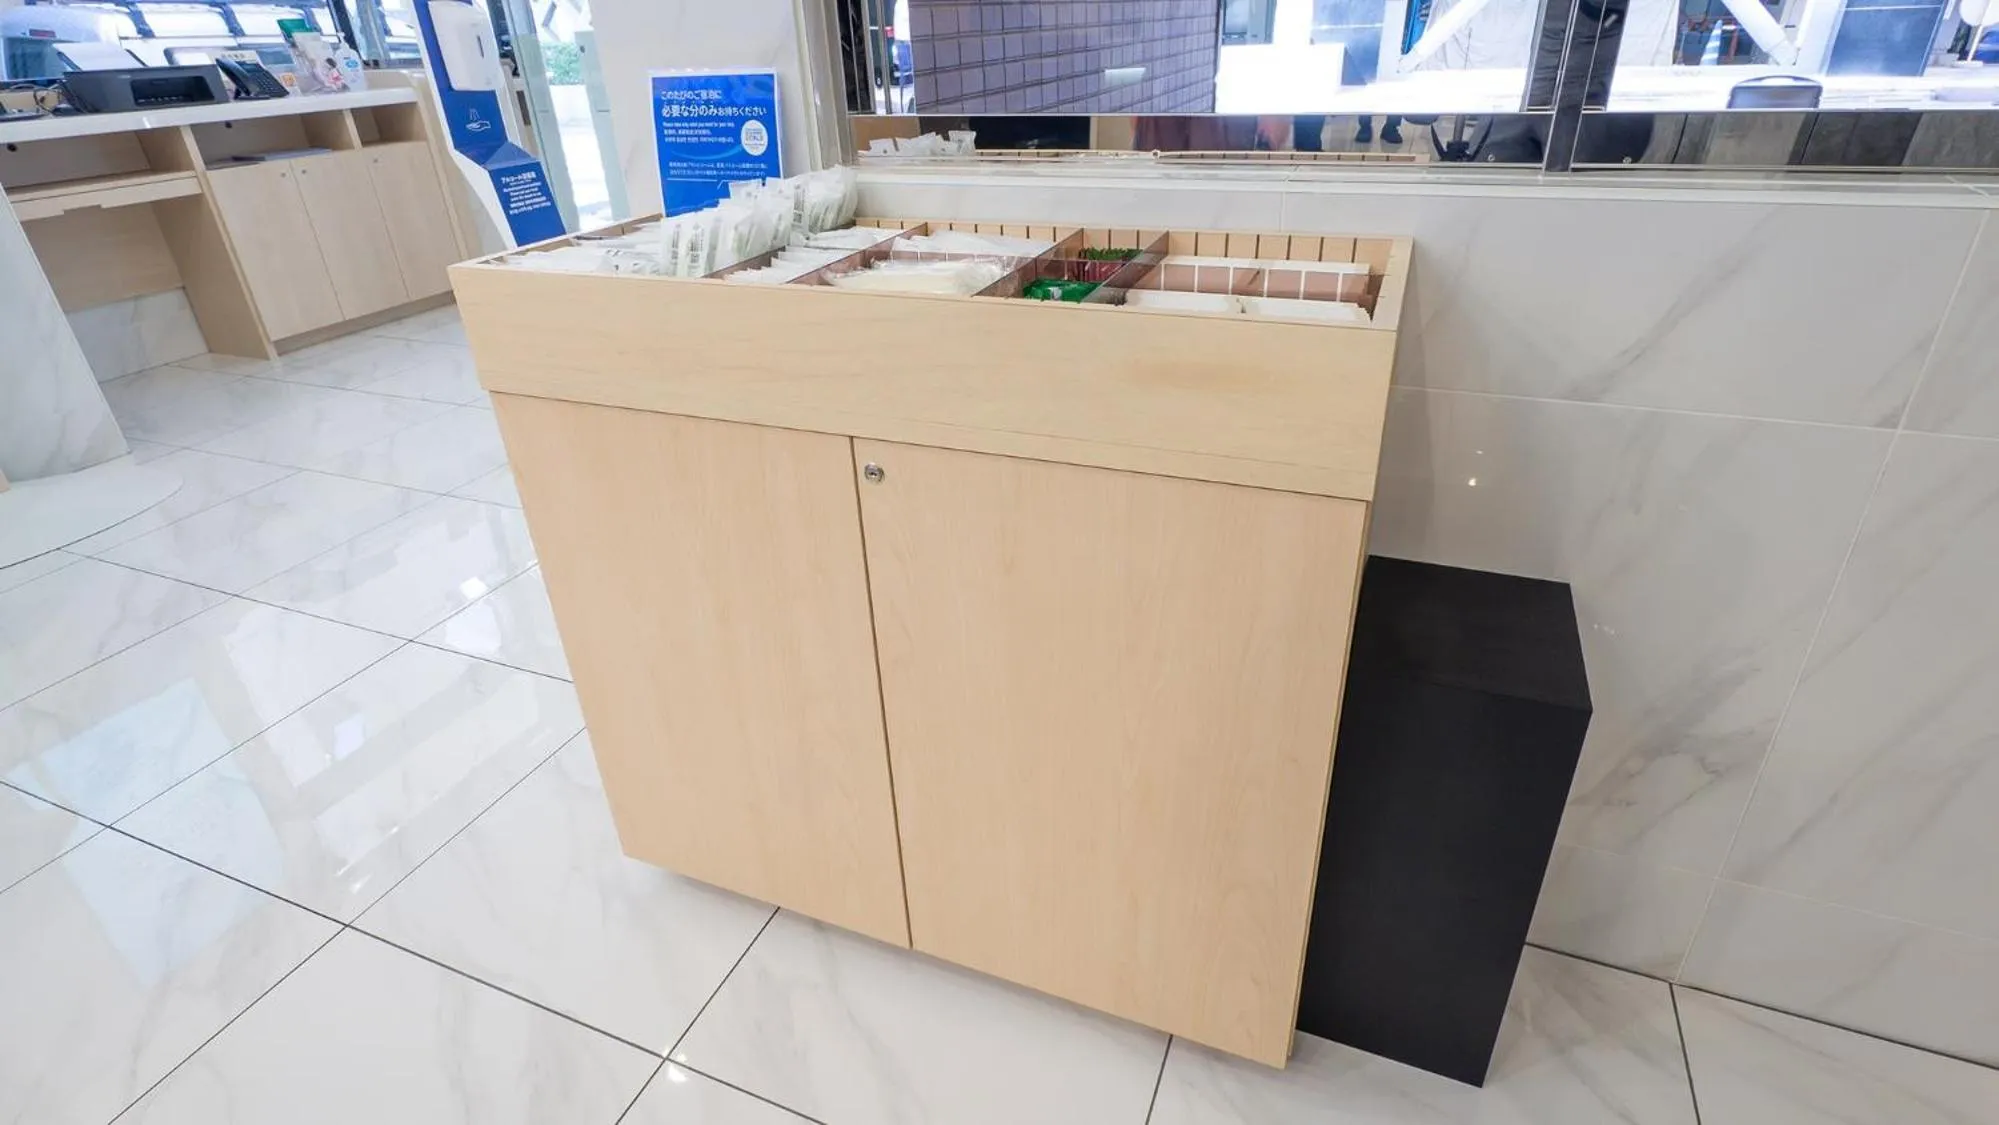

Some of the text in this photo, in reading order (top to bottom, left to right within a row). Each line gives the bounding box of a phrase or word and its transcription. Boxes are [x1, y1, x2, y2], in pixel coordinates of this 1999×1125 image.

[661, 104, 768, 117] 必要な分のみお持ちください
